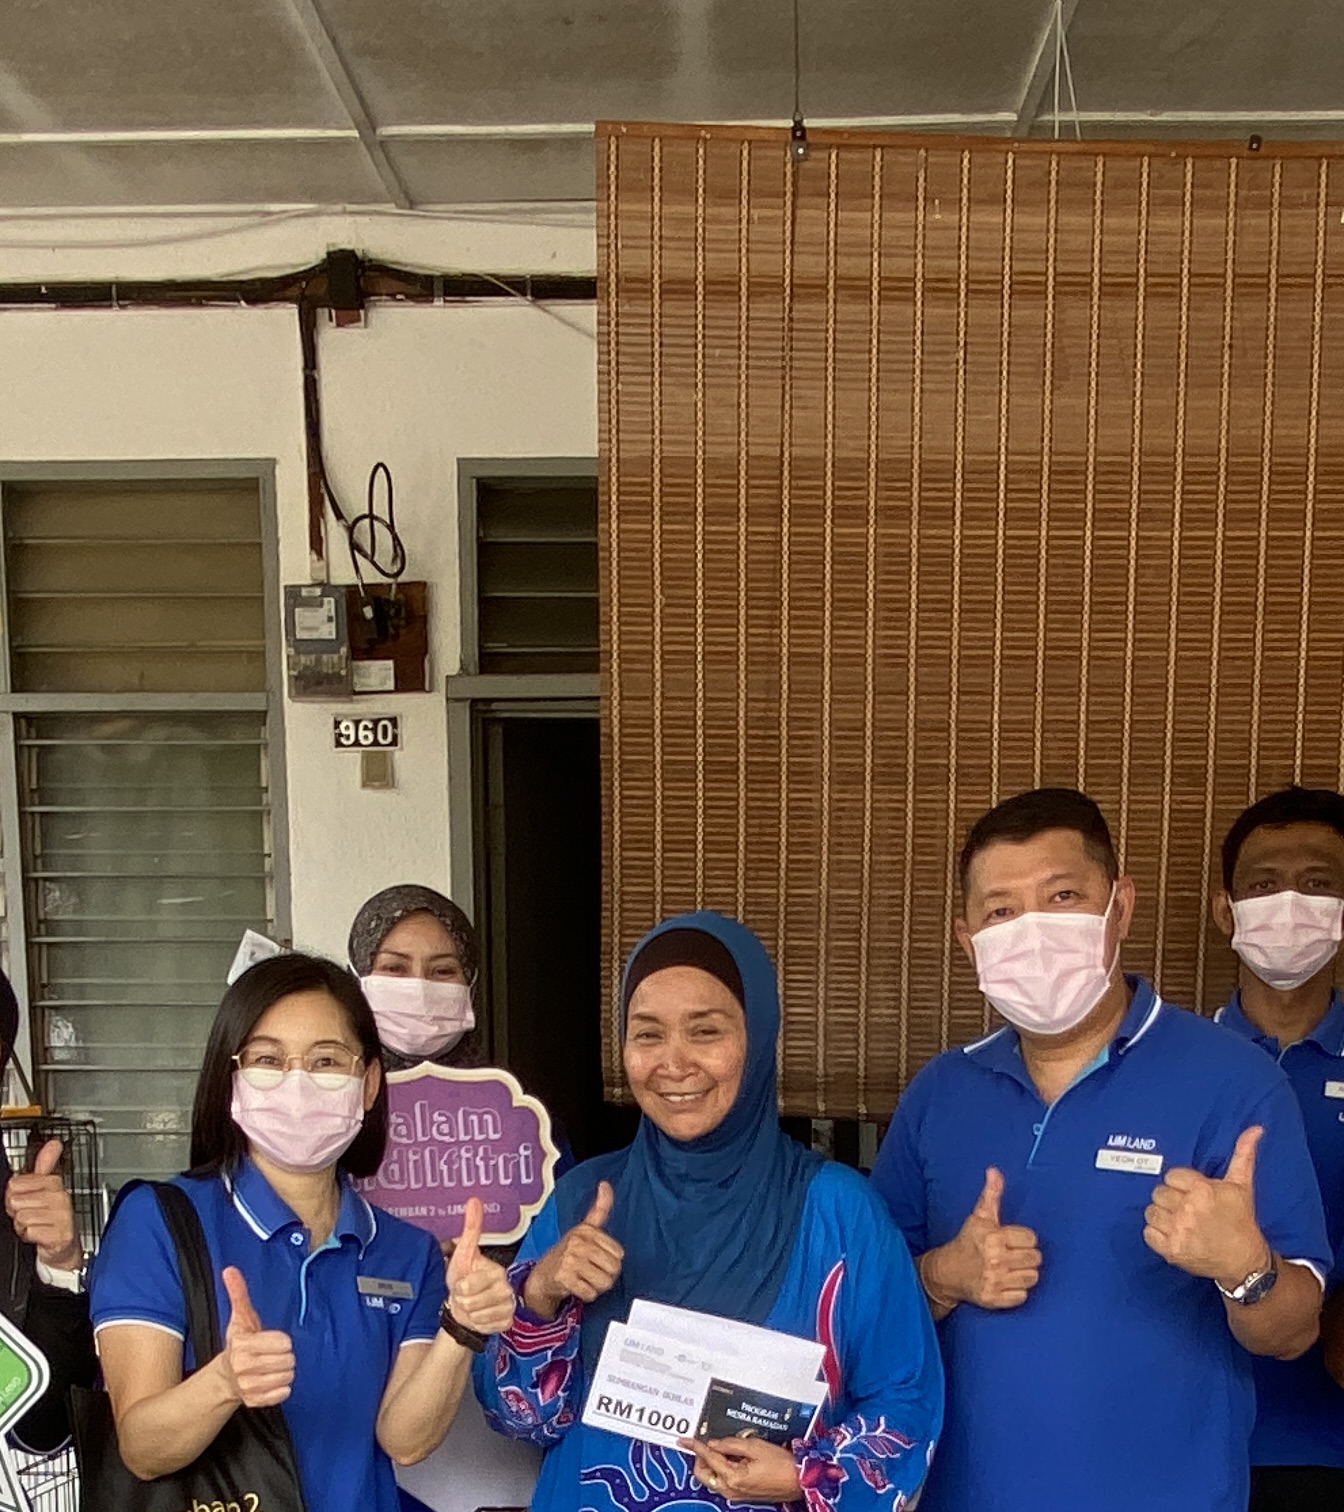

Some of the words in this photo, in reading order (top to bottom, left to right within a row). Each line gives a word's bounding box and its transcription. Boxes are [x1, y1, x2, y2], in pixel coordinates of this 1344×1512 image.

[339, 720, 393, 745] 960
[390, 1101, 502, 1143] alam
[1107, 1134, 1127, 1147] IJM
[1127, 1136, 1156, 1150] LAND
[596, 1394, 690, 1435] RM1000
